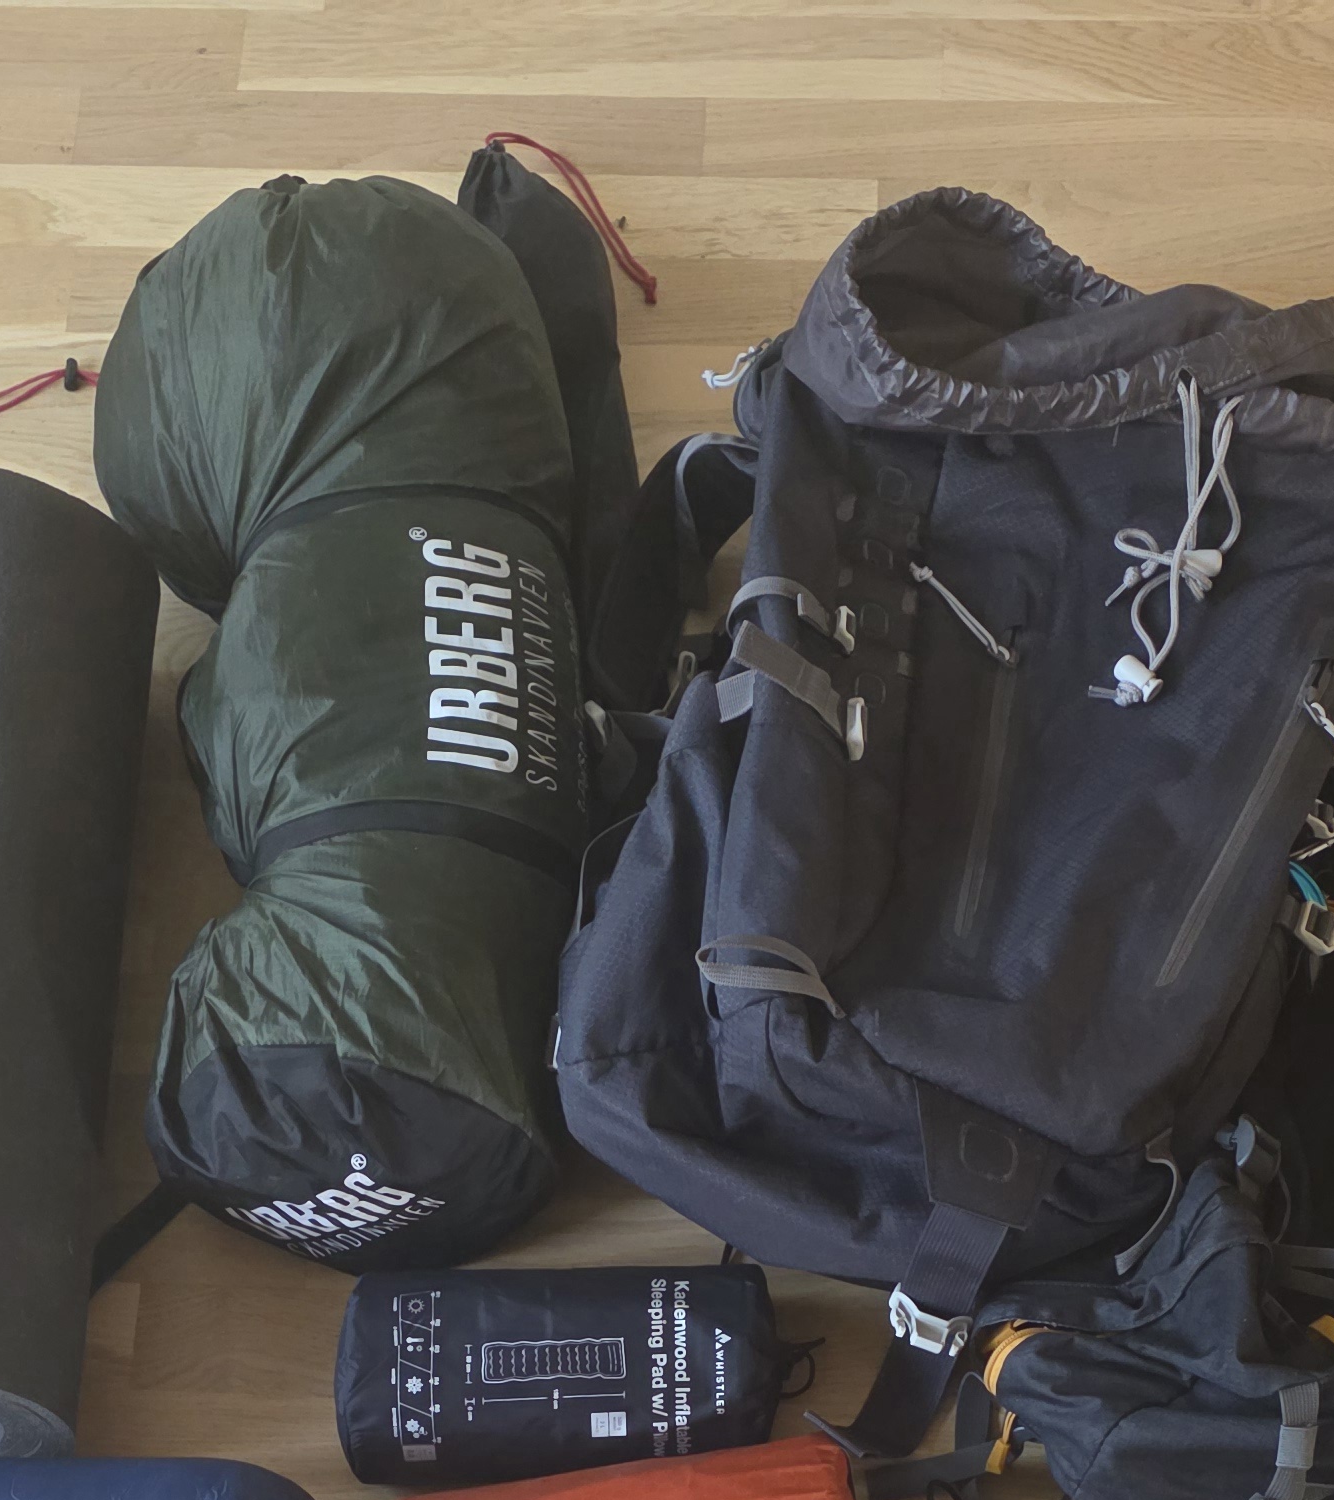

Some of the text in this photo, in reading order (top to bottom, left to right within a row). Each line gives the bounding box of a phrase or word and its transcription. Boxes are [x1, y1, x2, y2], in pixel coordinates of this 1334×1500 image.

[518, 559, 558, 792] SKANDINAVIEN
[648, 1278, 668, 1457] Sleeping Pad w/ Pillow
[674, 1280, 692, 1454] Kadenwood Inflatable
[715, 1350, 725, 1415] WHISTLER
